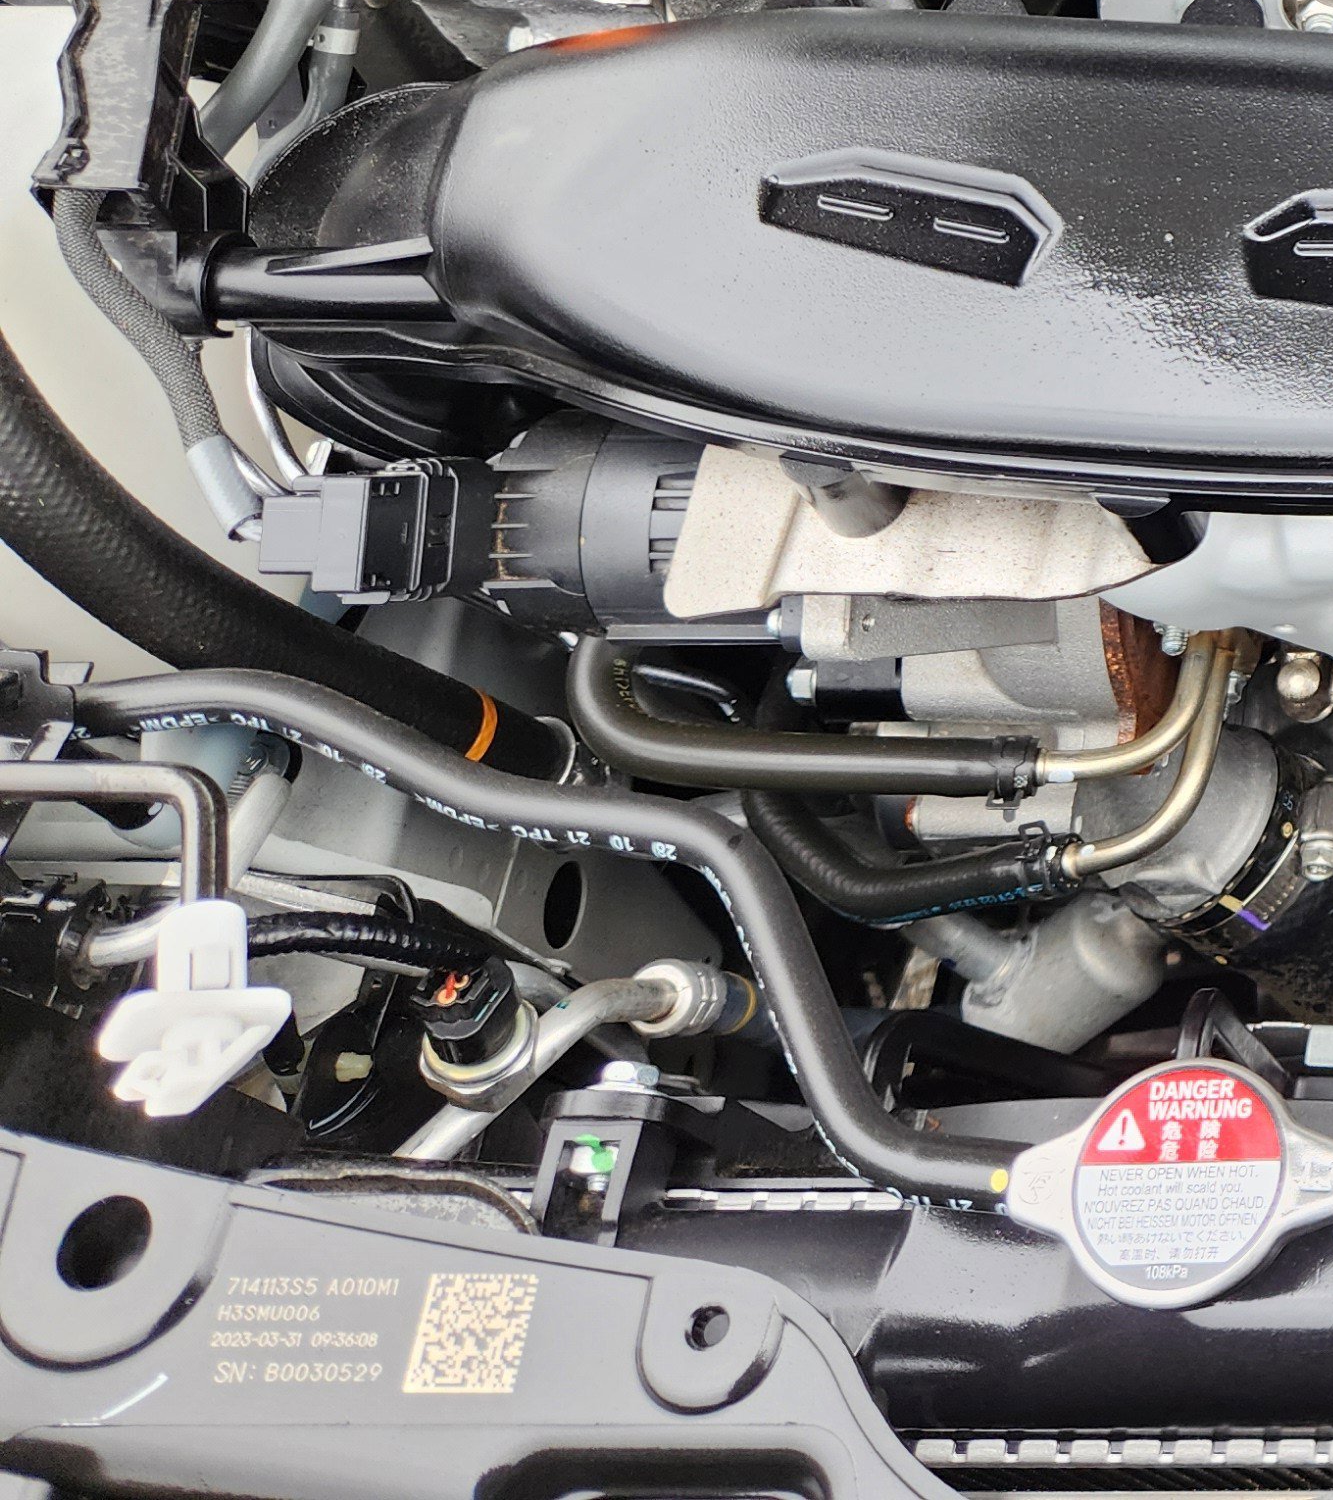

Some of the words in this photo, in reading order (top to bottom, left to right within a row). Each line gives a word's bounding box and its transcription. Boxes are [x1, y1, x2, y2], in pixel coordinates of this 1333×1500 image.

[510, 824, 559, 843] TPC
[1150, 1079, 1237, 1100] DANGER
[1148, 1098, 1253, 1121] WARNUNG
[1100, 1168, 1144, 1182] NEVER
[1147, 1167, 1183, 1180] OPEN
[1186, 1165, 1226, 1179] WHEN
[1229, 1164, 1260, 1178] HOT.
[1098, 1184, 1118, 1197] Hot
[1120, 1183, 1163, 1196] coolant
[1165, 1182, 1184, 1195] will
[1147, 1198, 1172, 1212] PAS
[1174, 1196, 1219, 1211] QUAND
[1086, 1216, 1117, 1232] NICHT
[1180, 1213, 1217, 1228] MOTOR
[1144, 1265, 1189, 1280] 108kPa
[216, 1304, 321, 1322] H3SMU006
[210, 1331, 303, 1348] 2023-03-31
[310, 1331, 379, 1348] 09:36:08
[263, 1362, 383, 1384] B0030529
